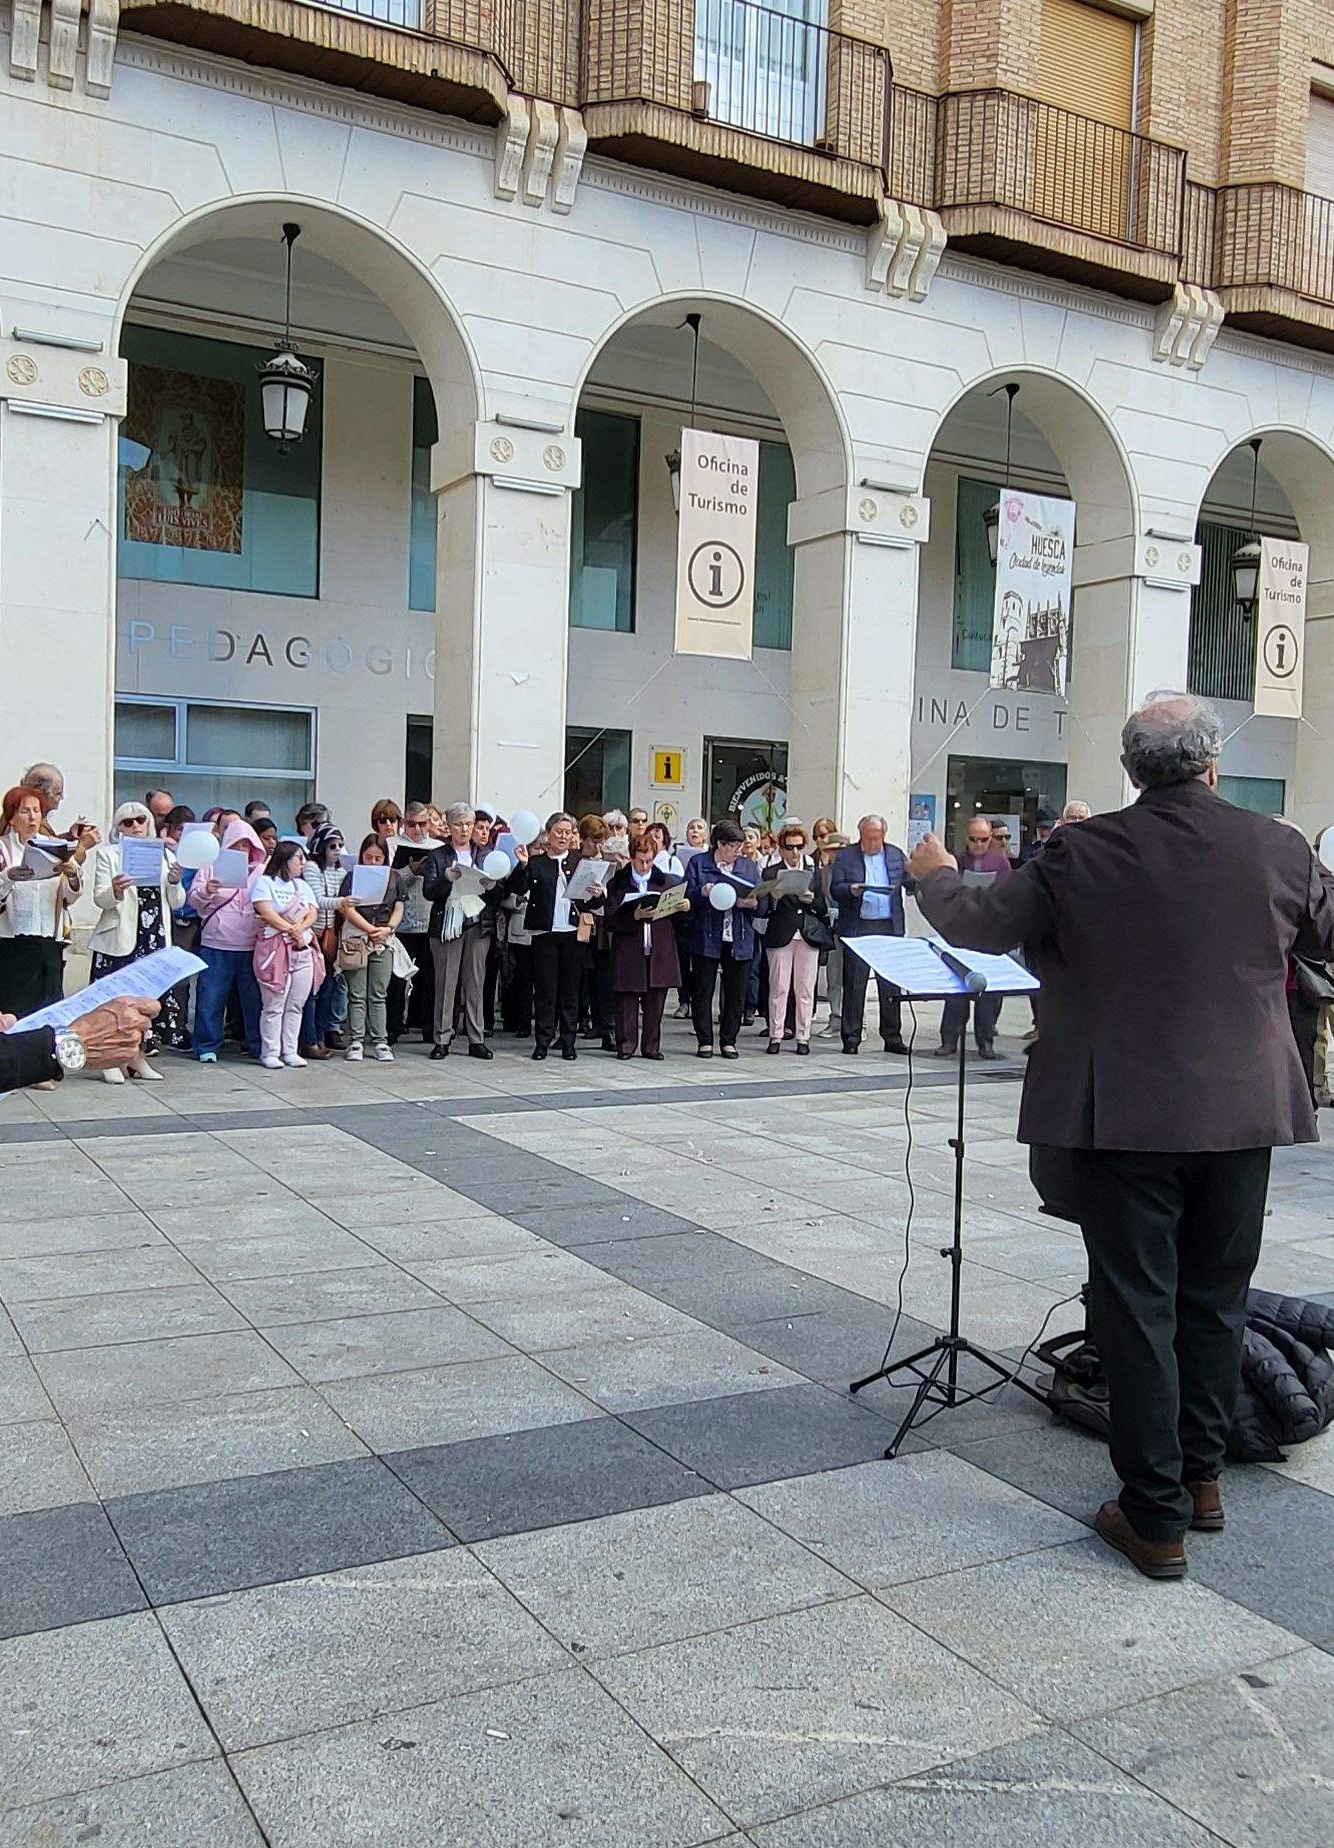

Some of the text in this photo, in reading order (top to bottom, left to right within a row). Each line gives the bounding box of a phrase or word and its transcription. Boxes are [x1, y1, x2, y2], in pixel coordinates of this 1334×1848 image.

[697, 454, 749, 476] Oficina
[730, 479, 748, 496] de
[688, 492, 748, 516] Turismo
[1031, 534, 1066, 560] HUESCA
[1009, 552, 1034, 570] Ciudad
[1033, 558, 1041, 571] de
[1271, 556, 1303, 572] Oficina
[1290, 576, 1302, 588] de
[1264, 587, 1302, 604] Turismo
[992, 704, 1031, 732] DE
[728, 771, 777, 813] BIENVENIDOS
